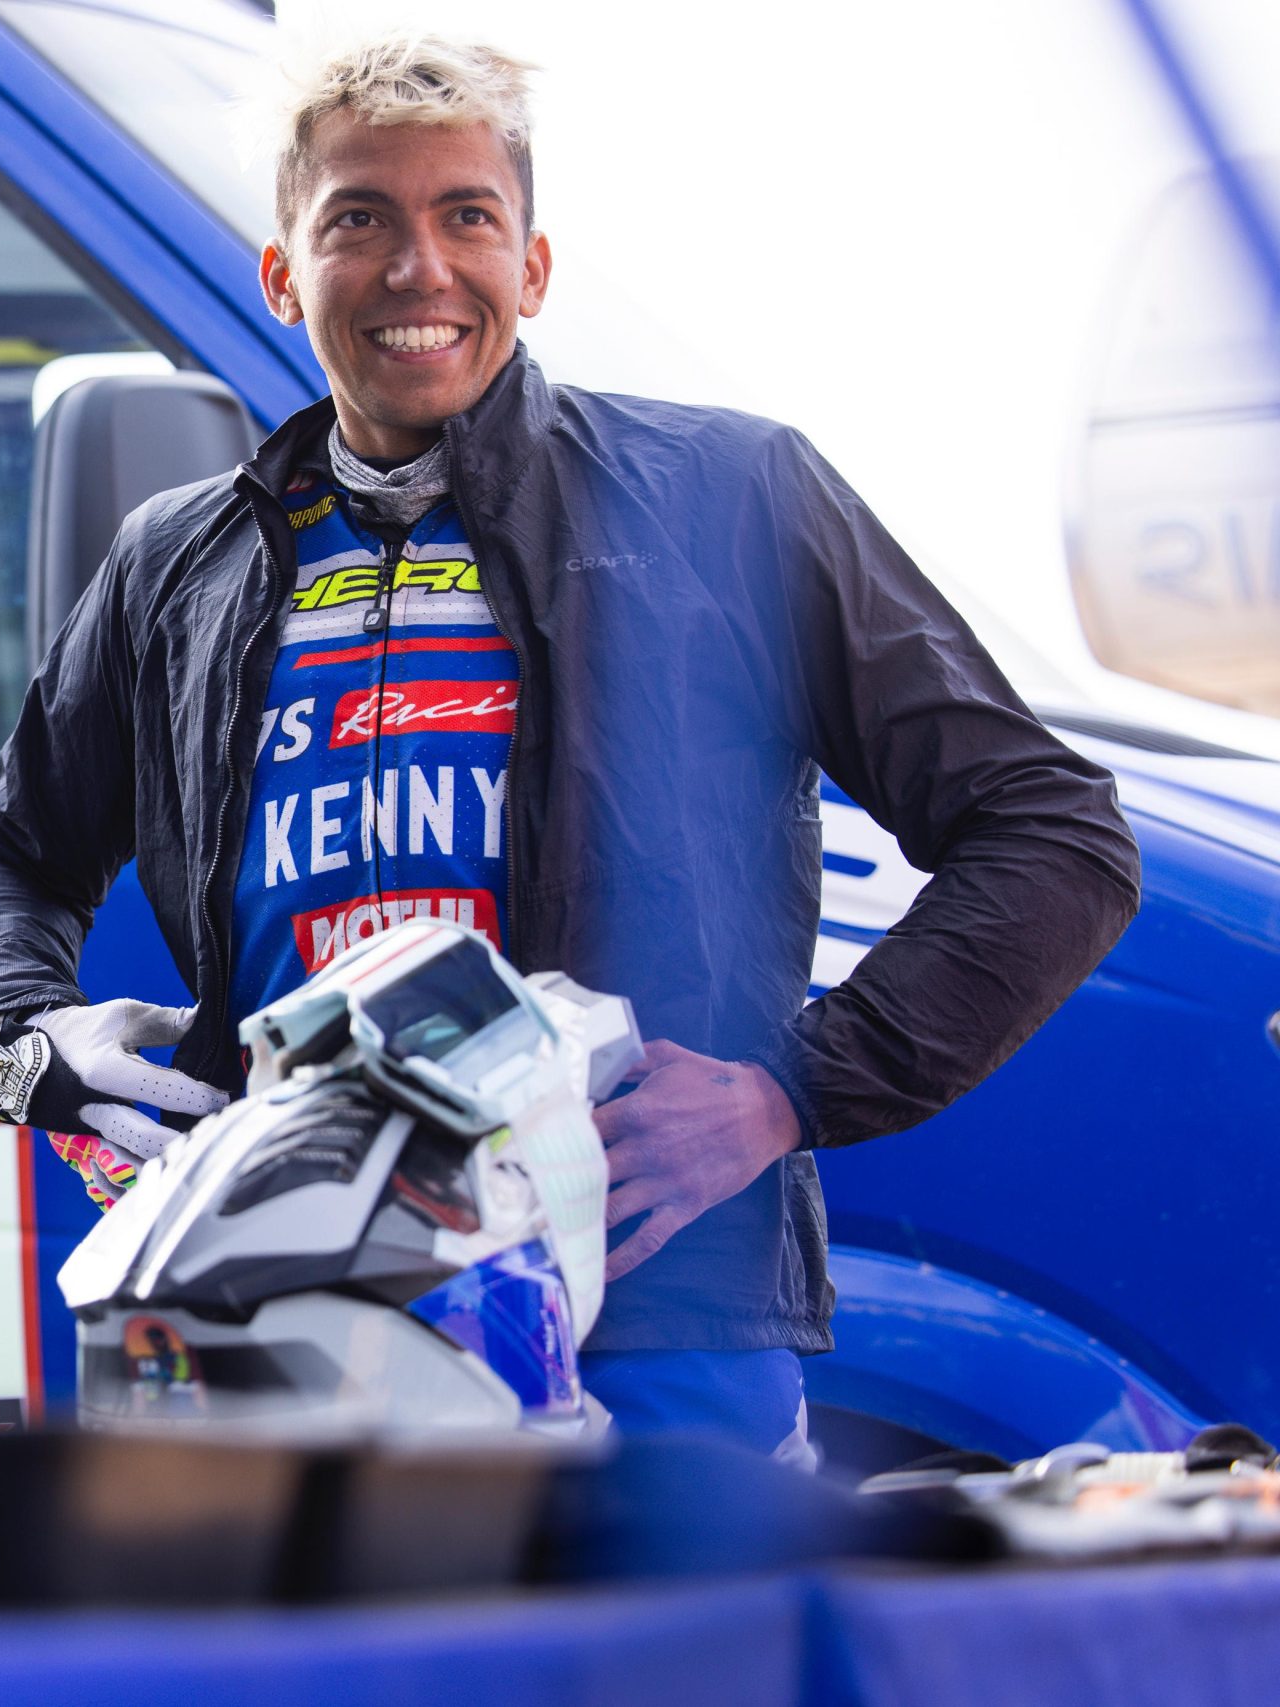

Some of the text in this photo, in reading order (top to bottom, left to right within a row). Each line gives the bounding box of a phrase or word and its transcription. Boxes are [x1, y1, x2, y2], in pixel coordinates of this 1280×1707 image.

[565, 554, 637, 572] CRAFT
[337, 686, 519, 740] Raci
[264, 765, 508, 888] KENNY
